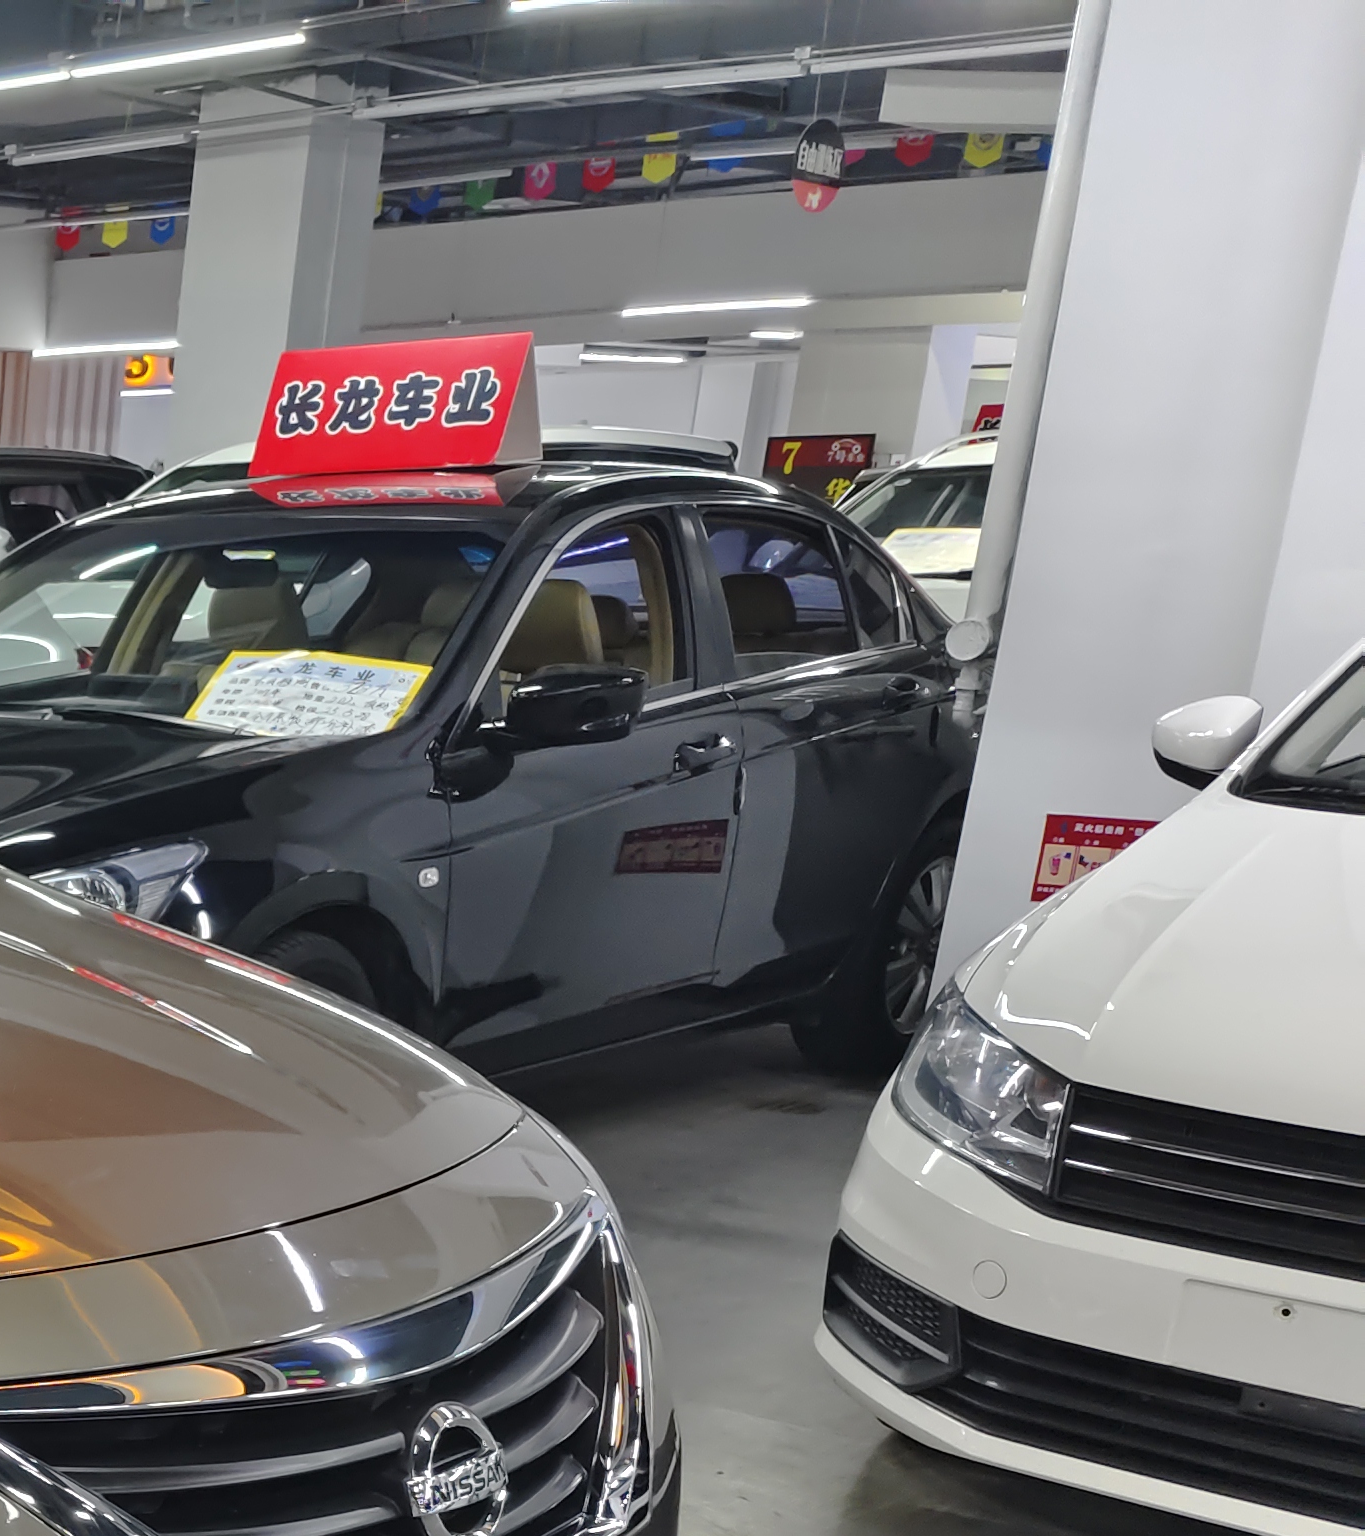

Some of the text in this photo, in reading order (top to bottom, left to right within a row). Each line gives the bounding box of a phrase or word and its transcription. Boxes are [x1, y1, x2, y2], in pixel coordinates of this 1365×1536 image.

[275, 366, 501, 439] 长龙车业
[782, 441, 802, 475] 7
[429, 1453, 507, 1506] NISSAN
